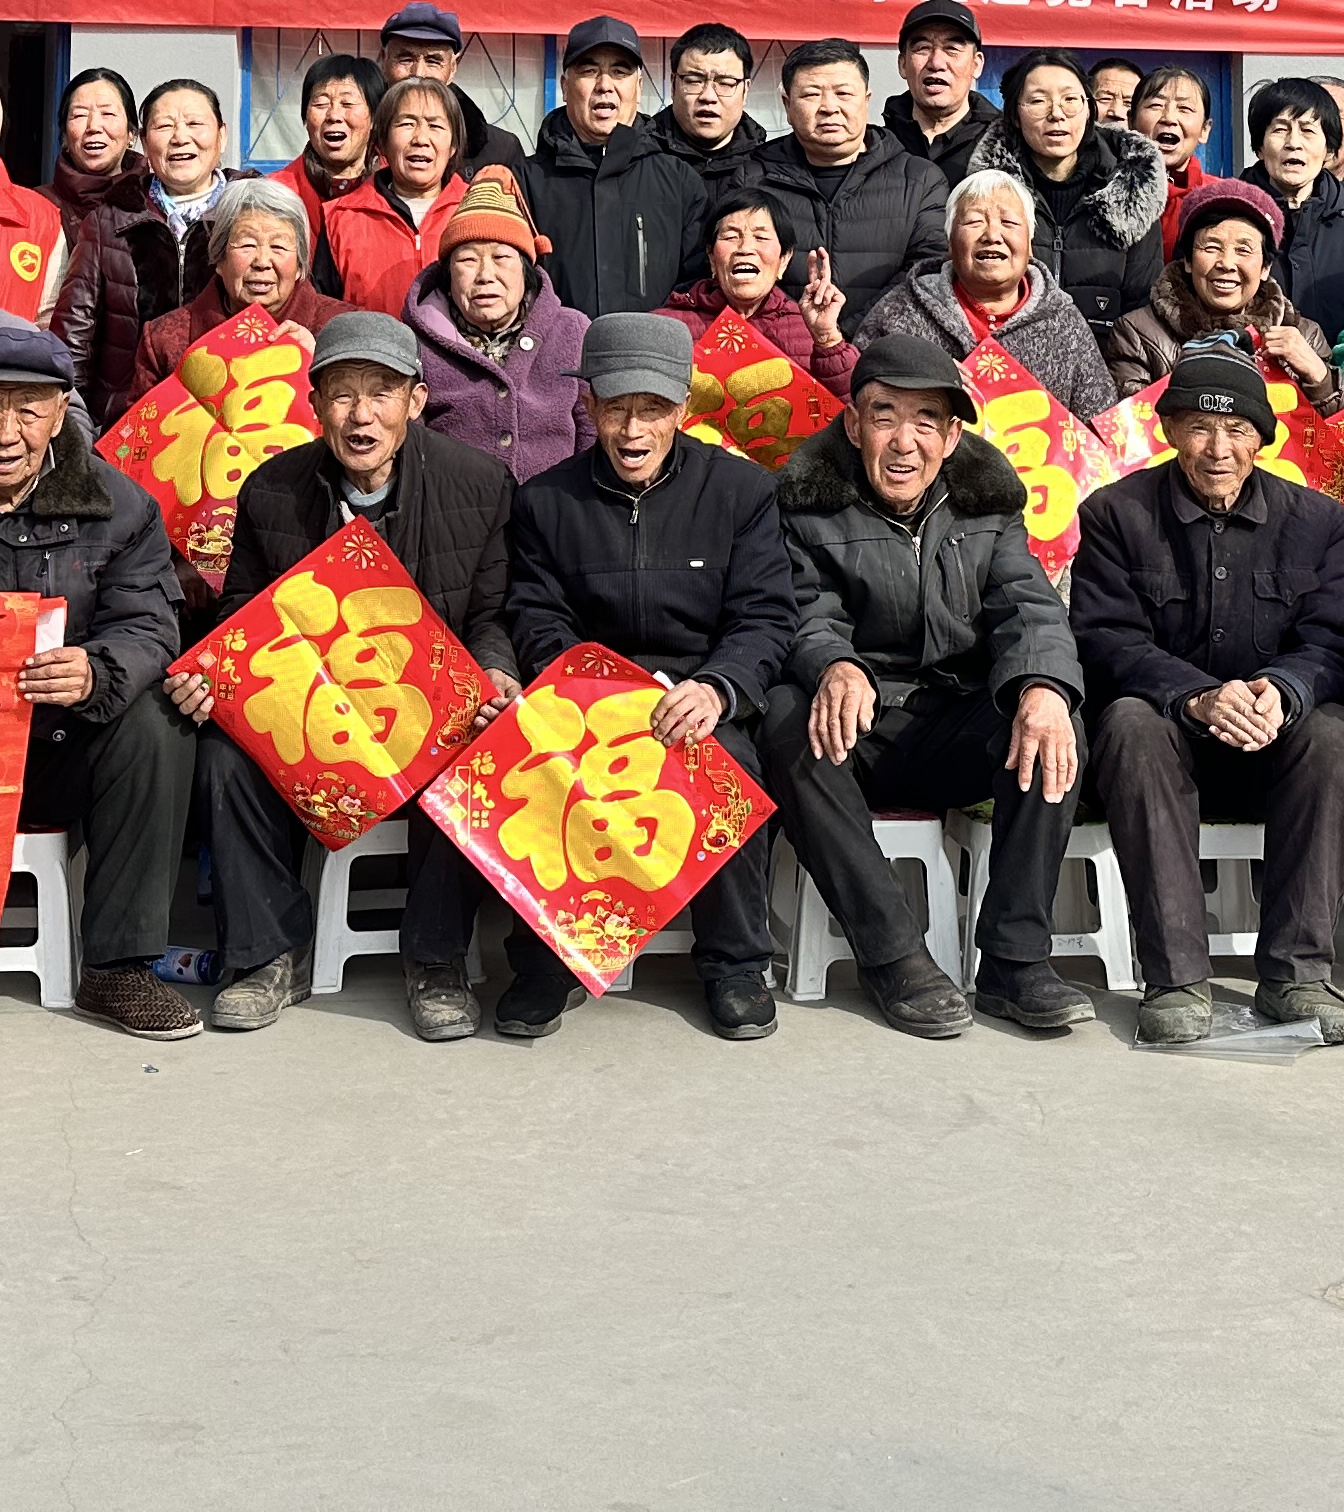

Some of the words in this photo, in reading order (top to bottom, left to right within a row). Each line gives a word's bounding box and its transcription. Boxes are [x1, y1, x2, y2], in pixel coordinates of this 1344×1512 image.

[152, 344, 314, 506] 福
[1199, 394, 1234, 413] OK
[243, 571, 433, 778] 福
[498, 685, 697, 893] 福
